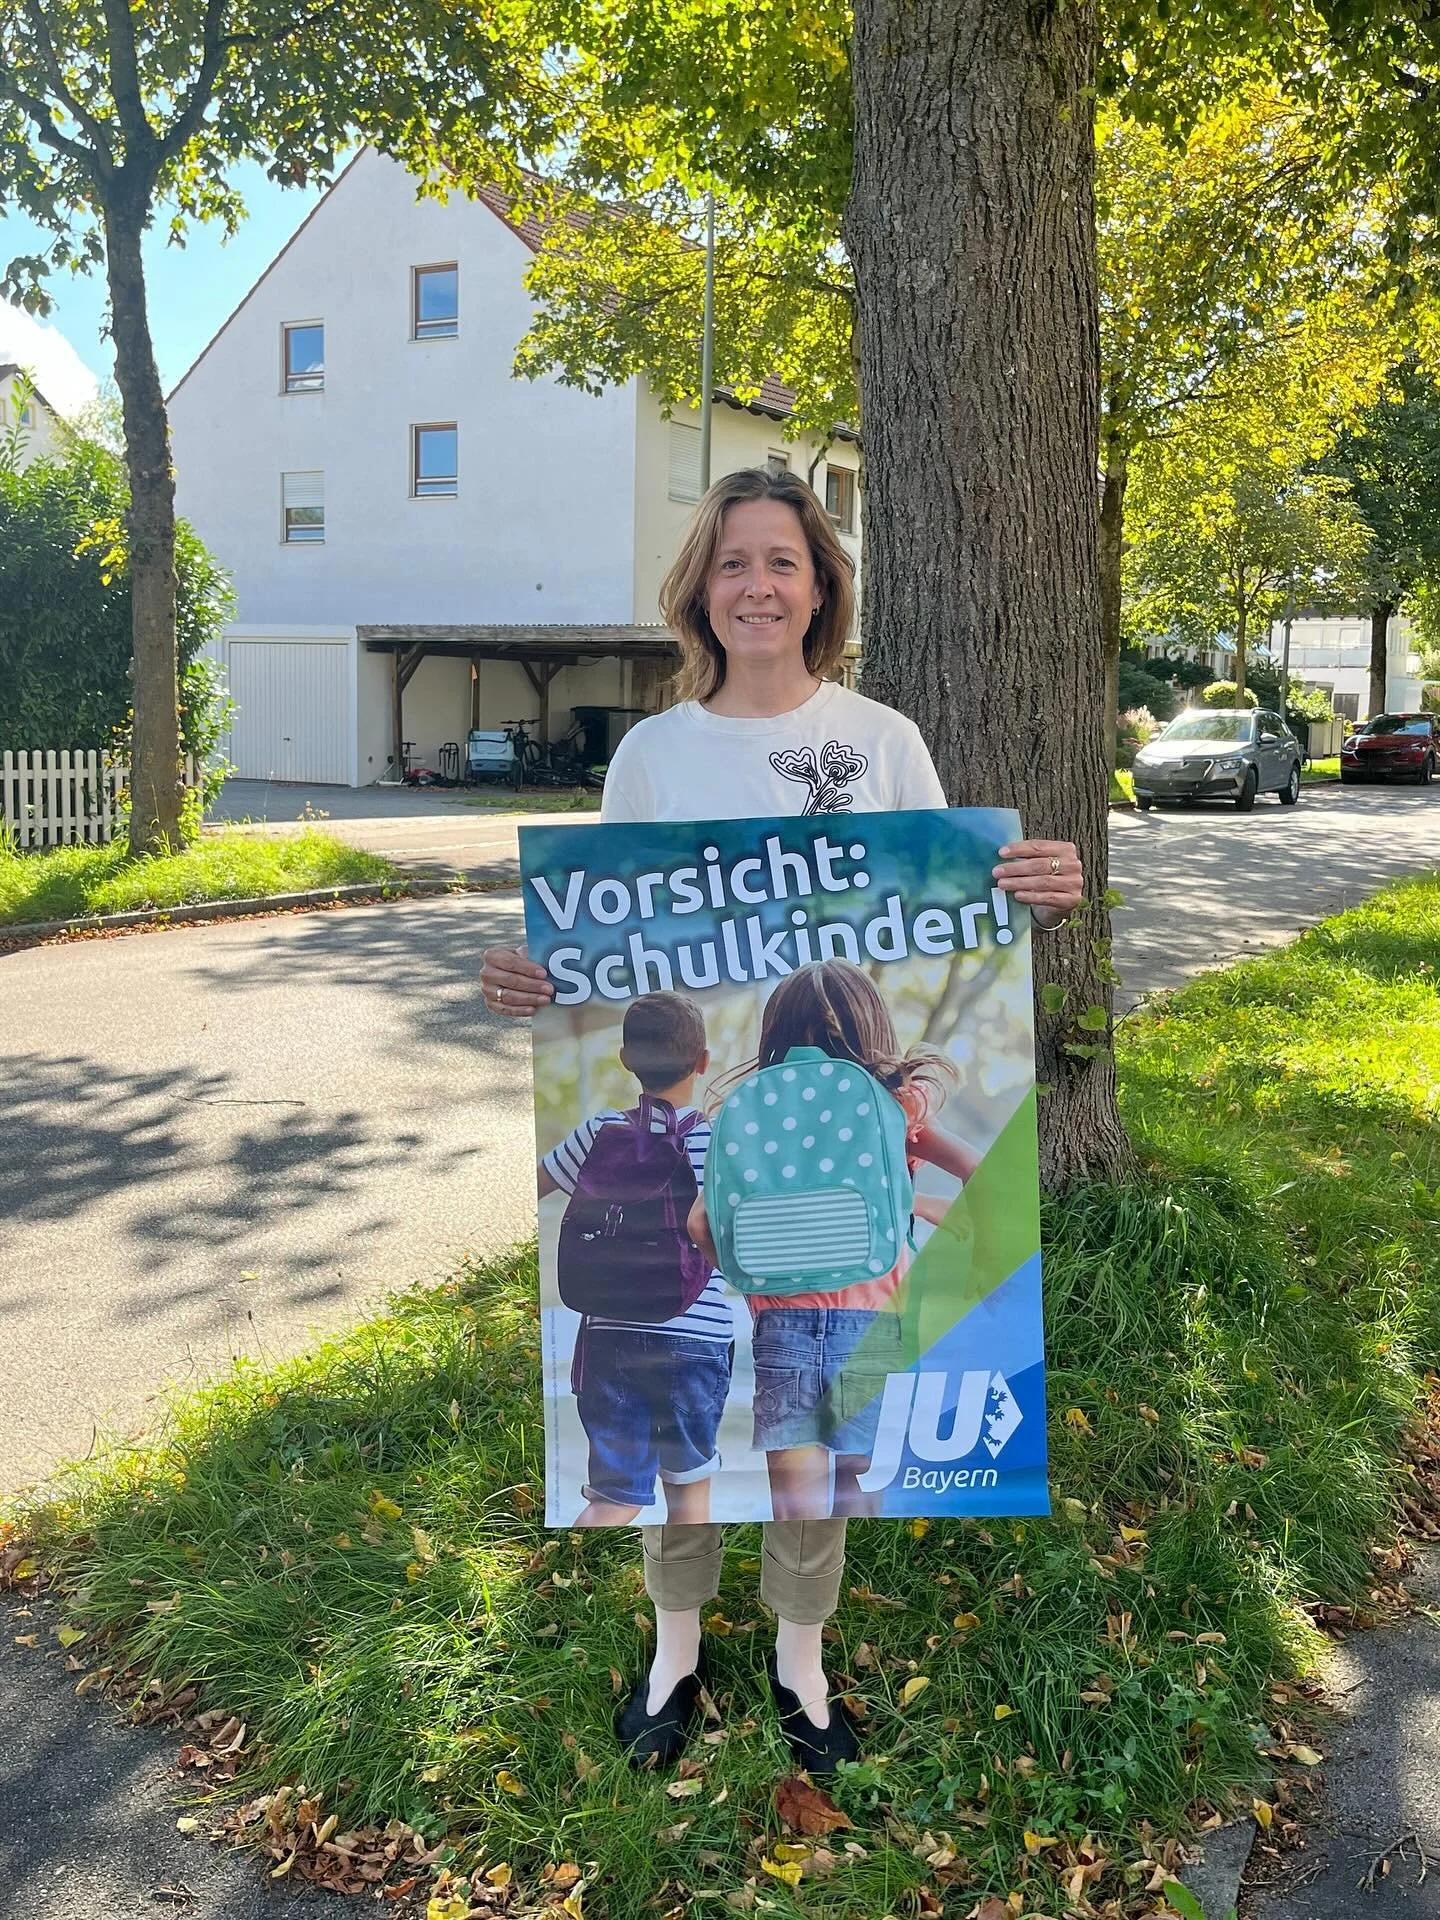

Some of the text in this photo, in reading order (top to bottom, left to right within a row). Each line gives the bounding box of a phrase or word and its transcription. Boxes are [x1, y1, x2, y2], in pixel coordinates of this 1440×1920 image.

[530, 836, 872, 931] Vorsicht:
[547, 887, 1014, 1005] Schulkinder!
[855, 1370, 991, 1493] JU
[902, 1466, 998, 1495] Bayern
